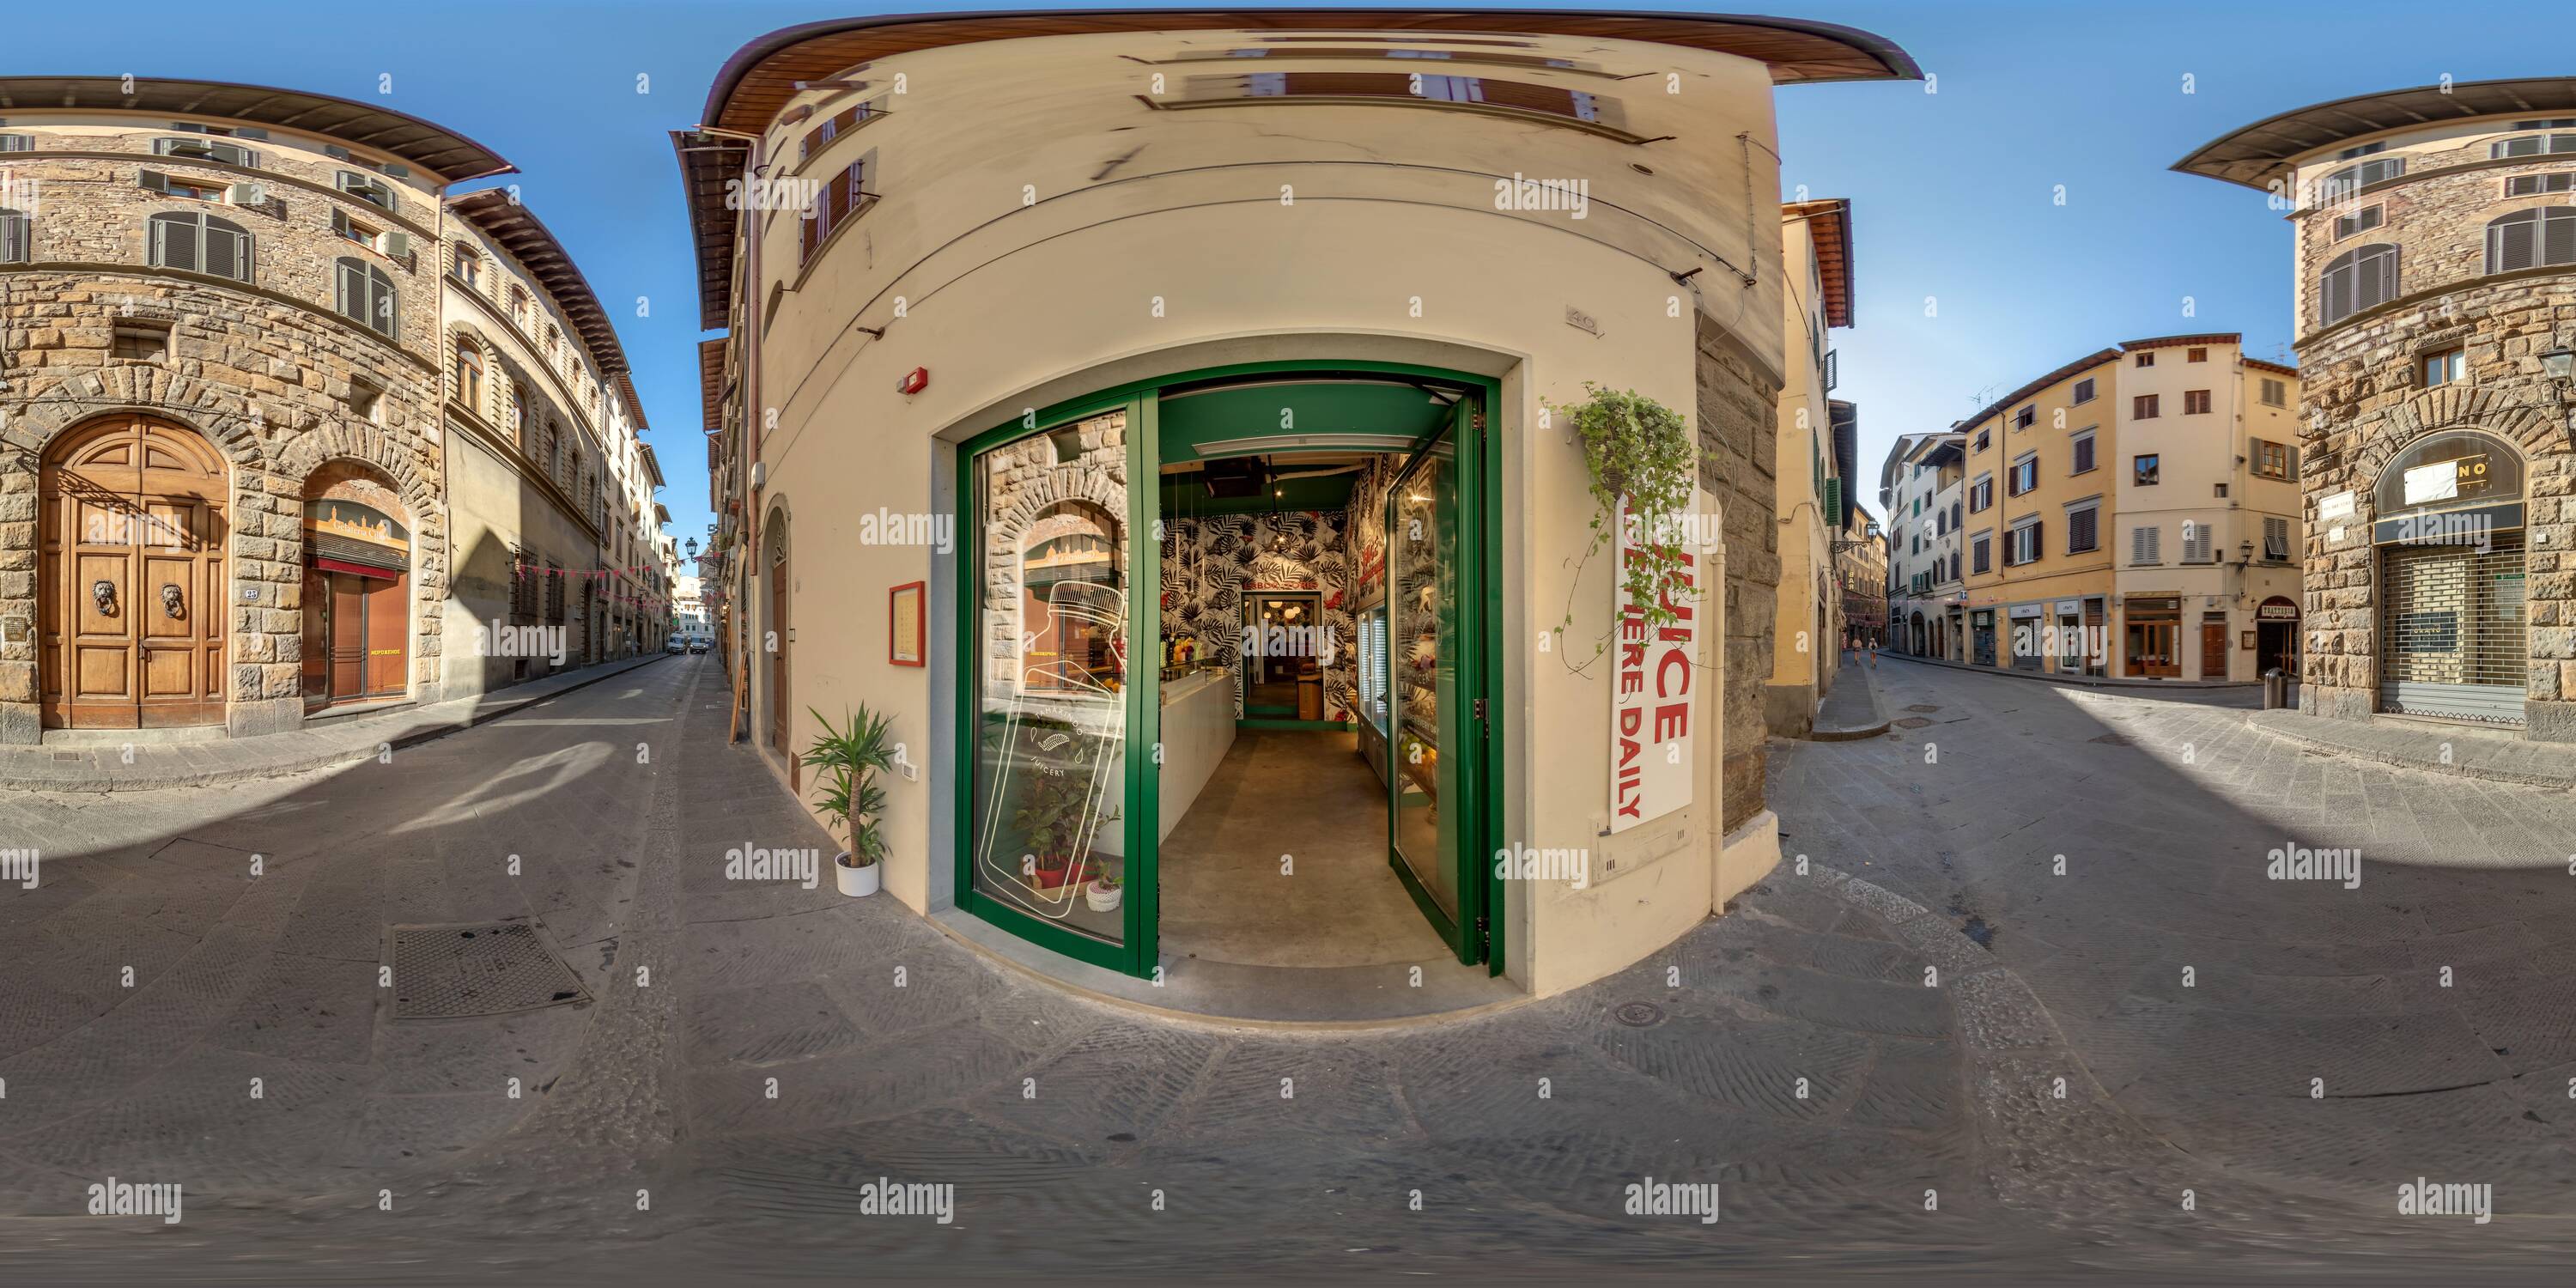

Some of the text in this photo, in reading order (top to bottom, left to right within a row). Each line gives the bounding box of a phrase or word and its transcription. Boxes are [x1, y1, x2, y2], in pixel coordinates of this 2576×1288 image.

[333, 520, 367, 537] Gelateria
[1036, 707, 1083, 736] TAMARINDO
[1030, 756, 1065, 777] JUICERY
[1619, 707, 1643, 819] DAILY
